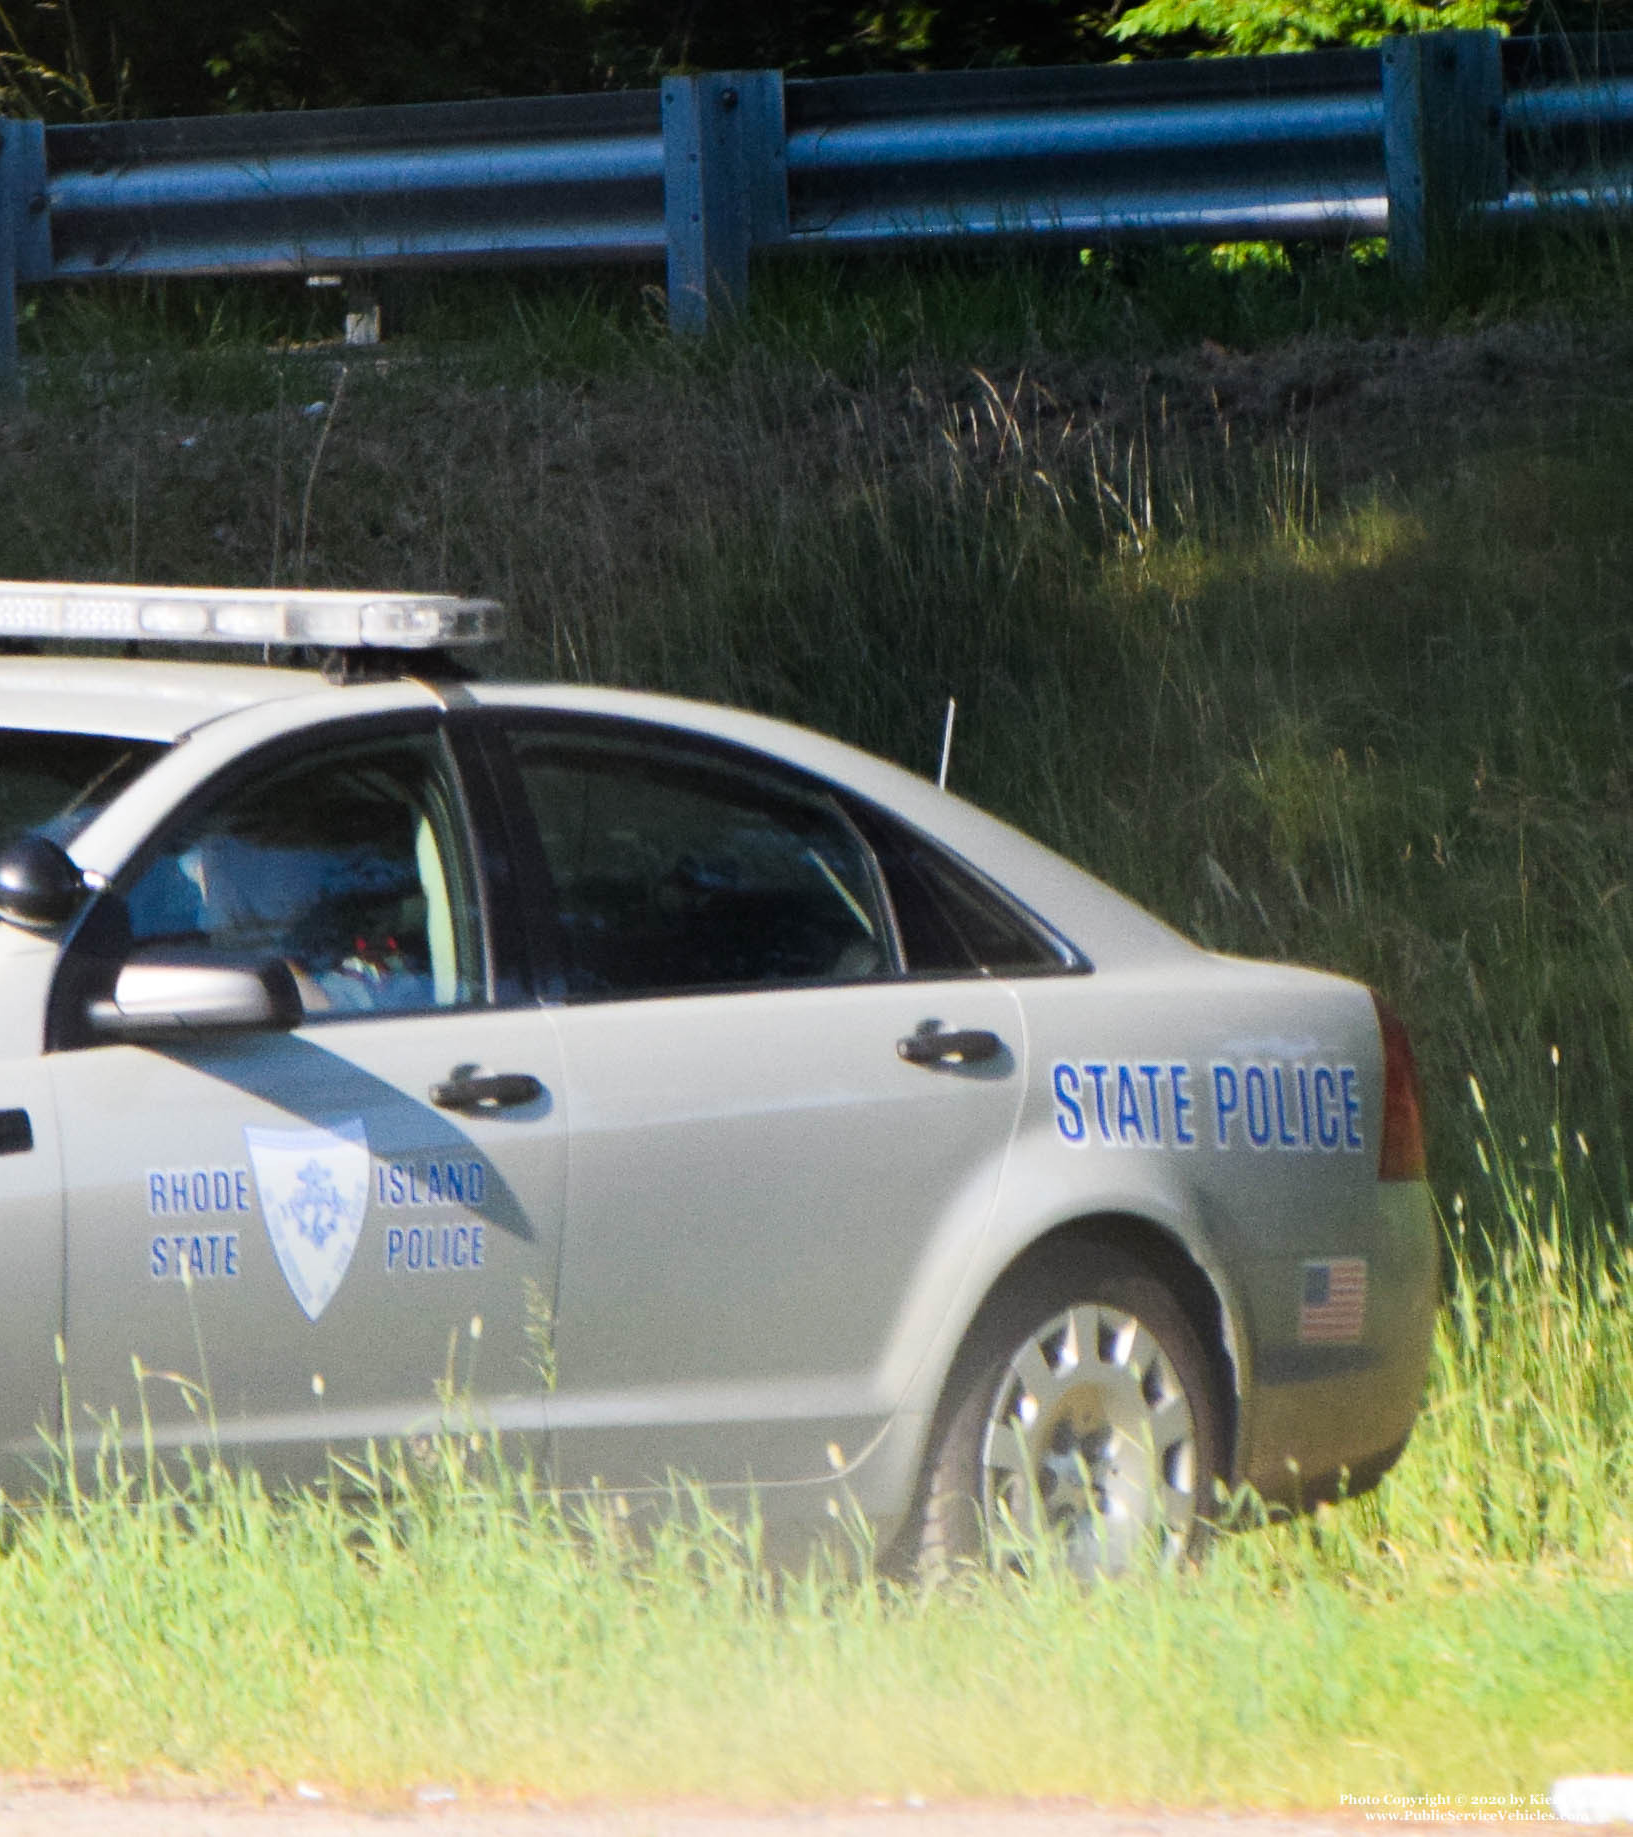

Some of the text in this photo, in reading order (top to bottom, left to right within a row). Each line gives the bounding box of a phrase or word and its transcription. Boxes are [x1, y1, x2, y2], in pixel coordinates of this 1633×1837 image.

[1053, 1062, 1363, 1148] STATE POLICE
[148, 1161, 485, 1214] RHODE ISLAND
[151, 1225, 484, 1277] STATE POLICE
